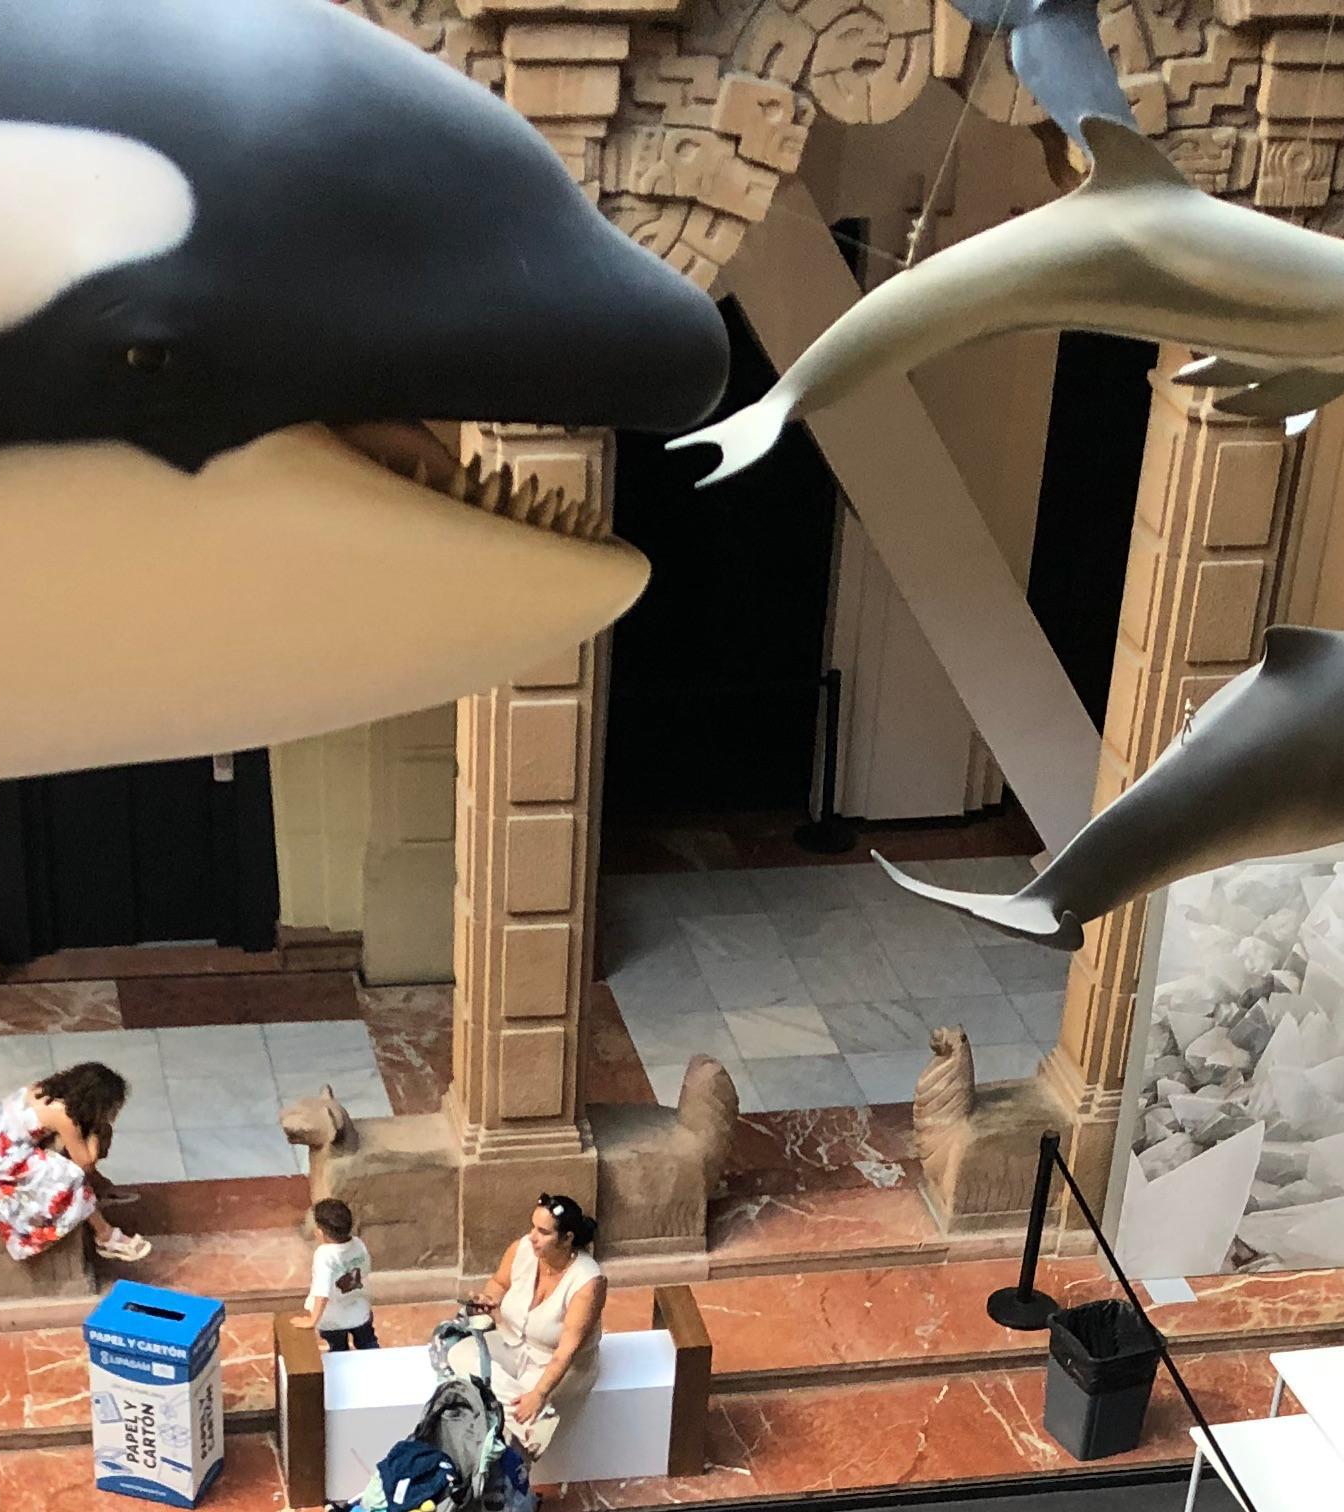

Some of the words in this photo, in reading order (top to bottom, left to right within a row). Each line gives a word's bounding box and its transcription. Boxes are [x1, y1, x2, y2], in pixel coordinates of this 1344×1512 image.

[89, 1330, 126, 1347] PAPEL
[127, 1337, 136, 1348] Y
[137, 1340, 187, 1359] CARTÓN
[123, 1400, 137, 1410] Y
[124, 1415, 140, 1464] PAPEL
[140, 1402, 157, 1469] CARTÓN
